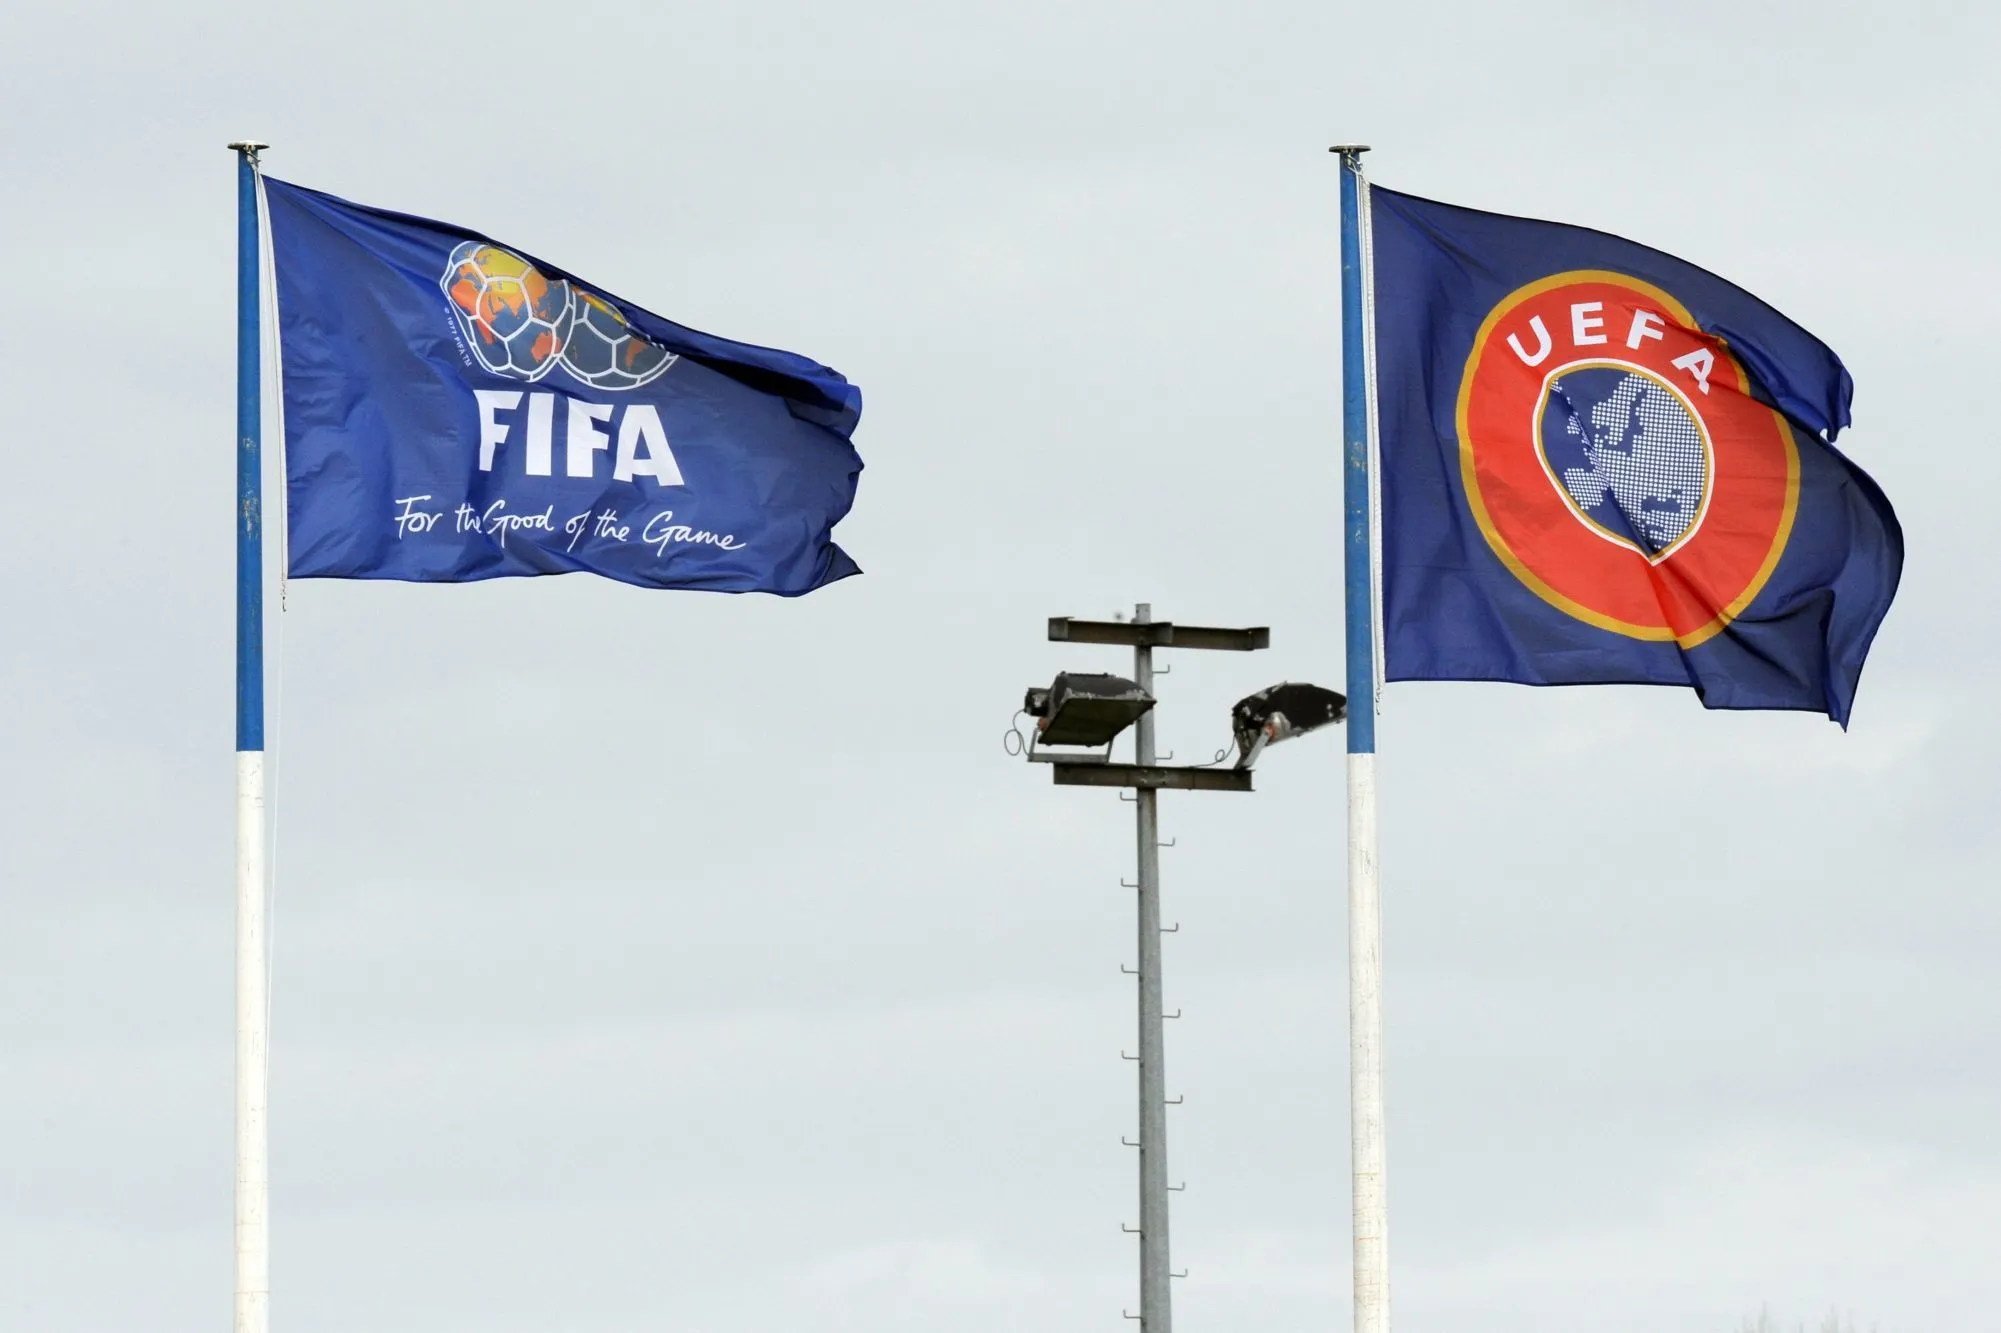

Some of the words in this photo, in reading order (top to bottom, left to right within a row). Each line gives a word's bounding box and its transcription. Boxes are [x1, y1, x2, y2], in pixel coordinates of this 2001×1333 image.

[1506, 301, 1715, 396] UEFA
[473, 389, 686, 487] FIFA
[394, 495, 443, 540] For
[454, 502, 483, 534] the
[482, 499, 555, 549] Good
[565, 510, 592, 553] of
[593, 508, 630, 542] the
[642, 510, 747, 558] Game
